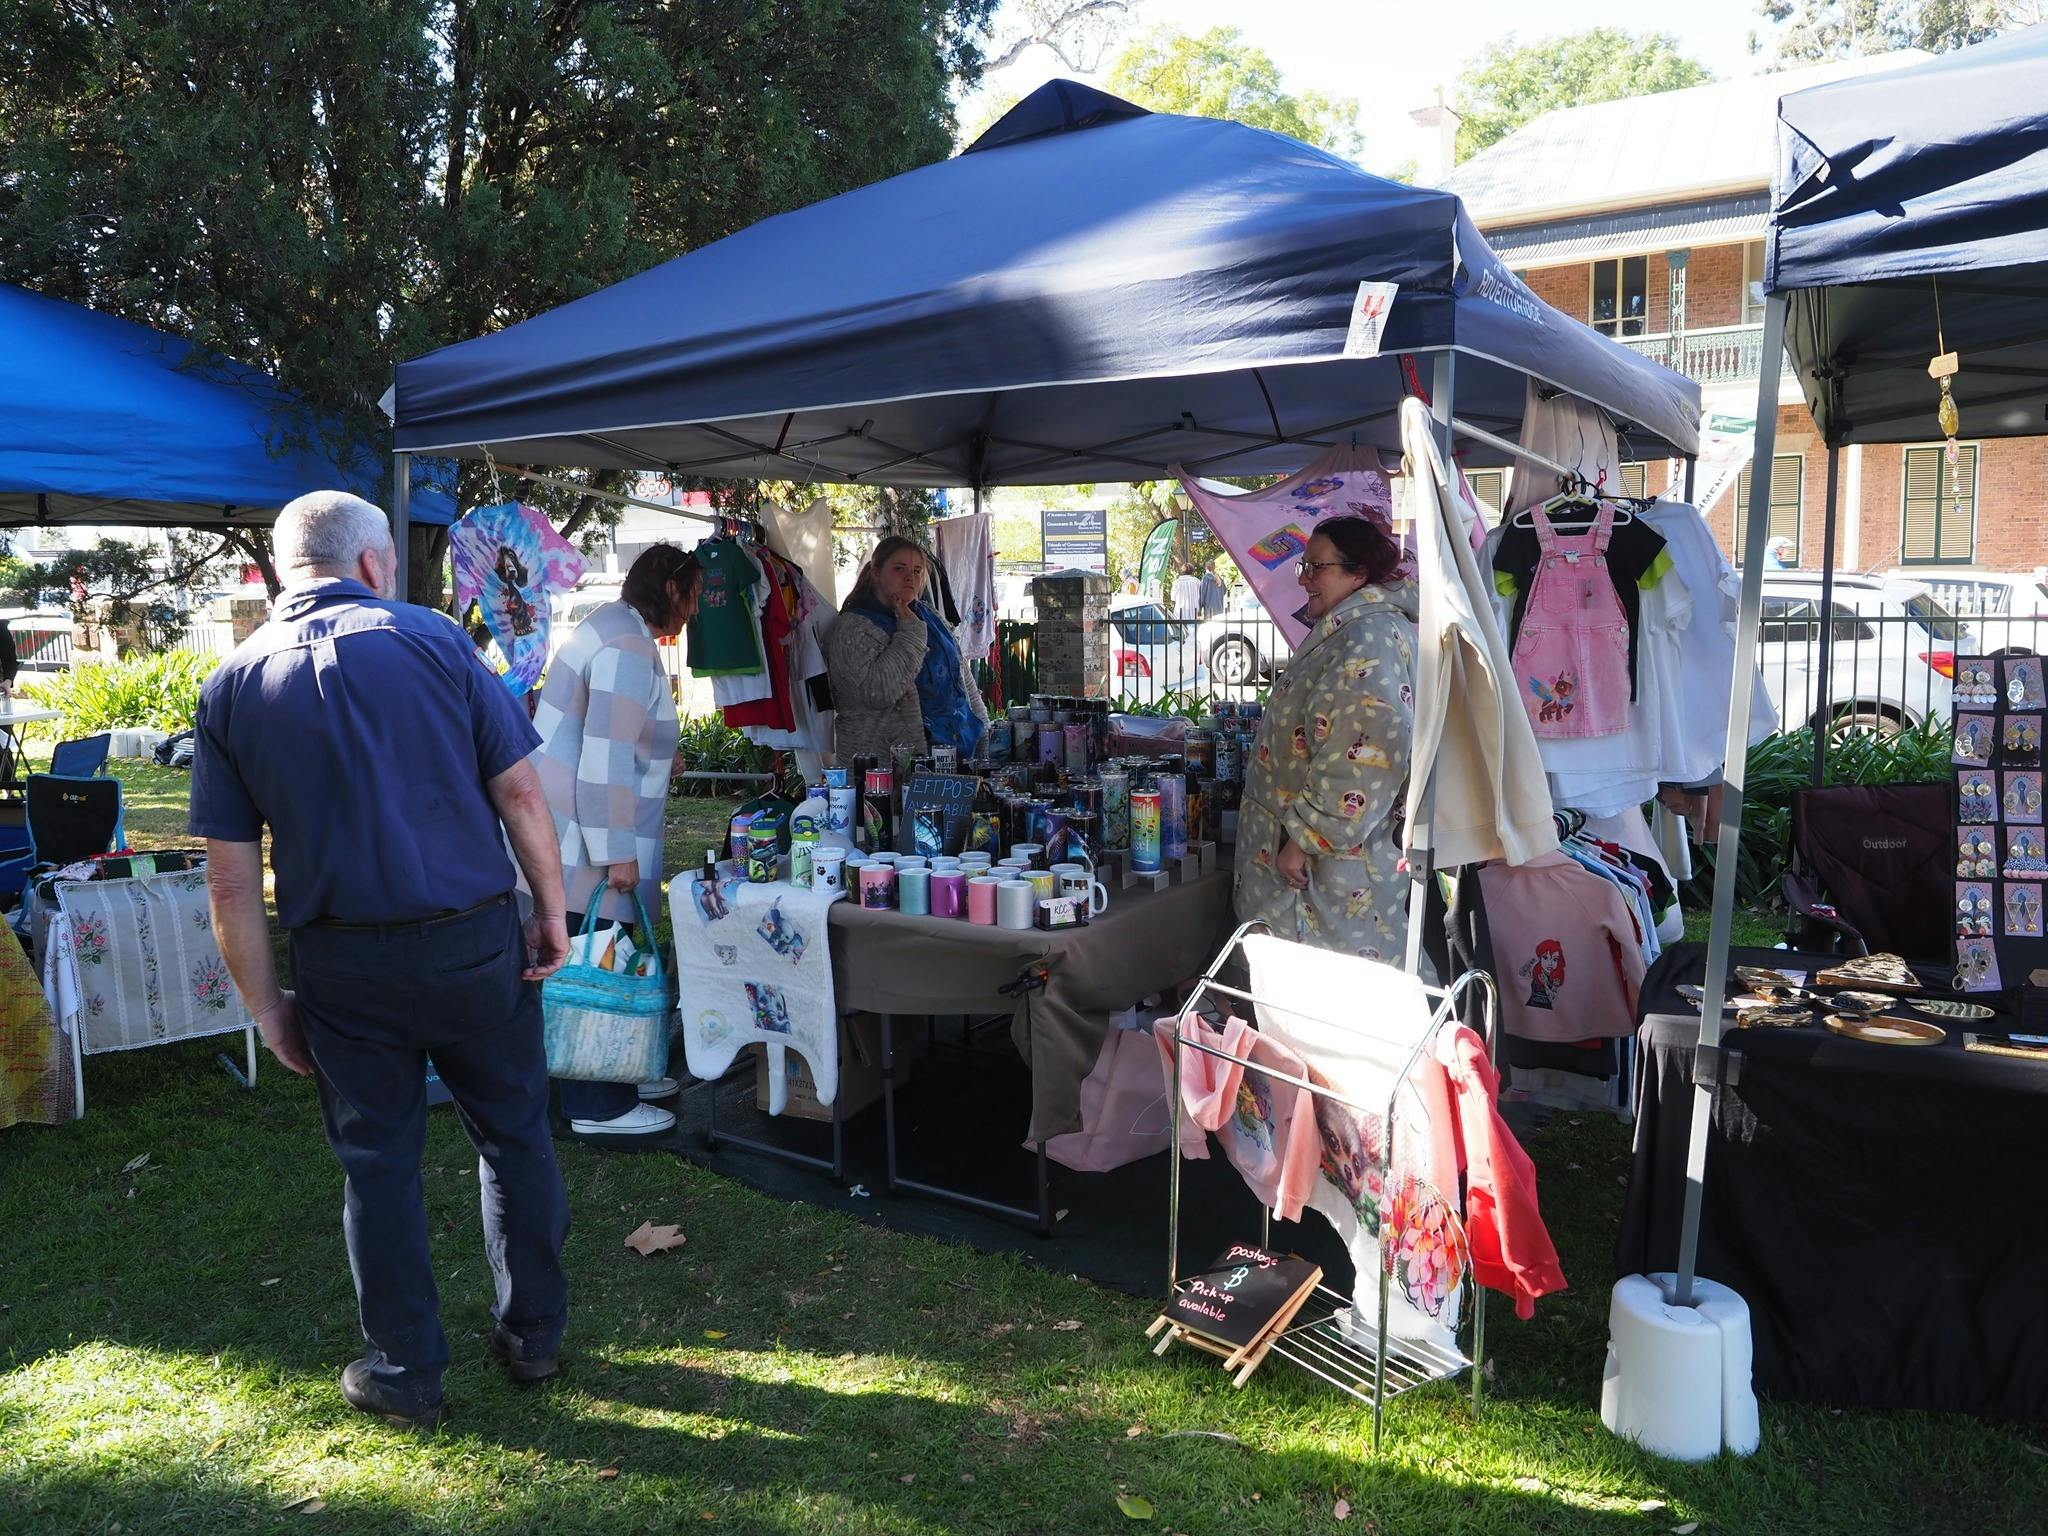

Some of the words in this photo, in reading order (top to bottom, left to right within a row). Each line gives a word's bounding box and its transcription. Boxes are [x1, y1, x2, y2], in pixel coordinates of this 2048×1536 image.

[913, 778, 974, 799] EFTPOS
[1863, 839, 1907, 849] Outdoor
[1226, 1245, 1279, 1269] postage
[1178, 1297, 1227, 1322] available
